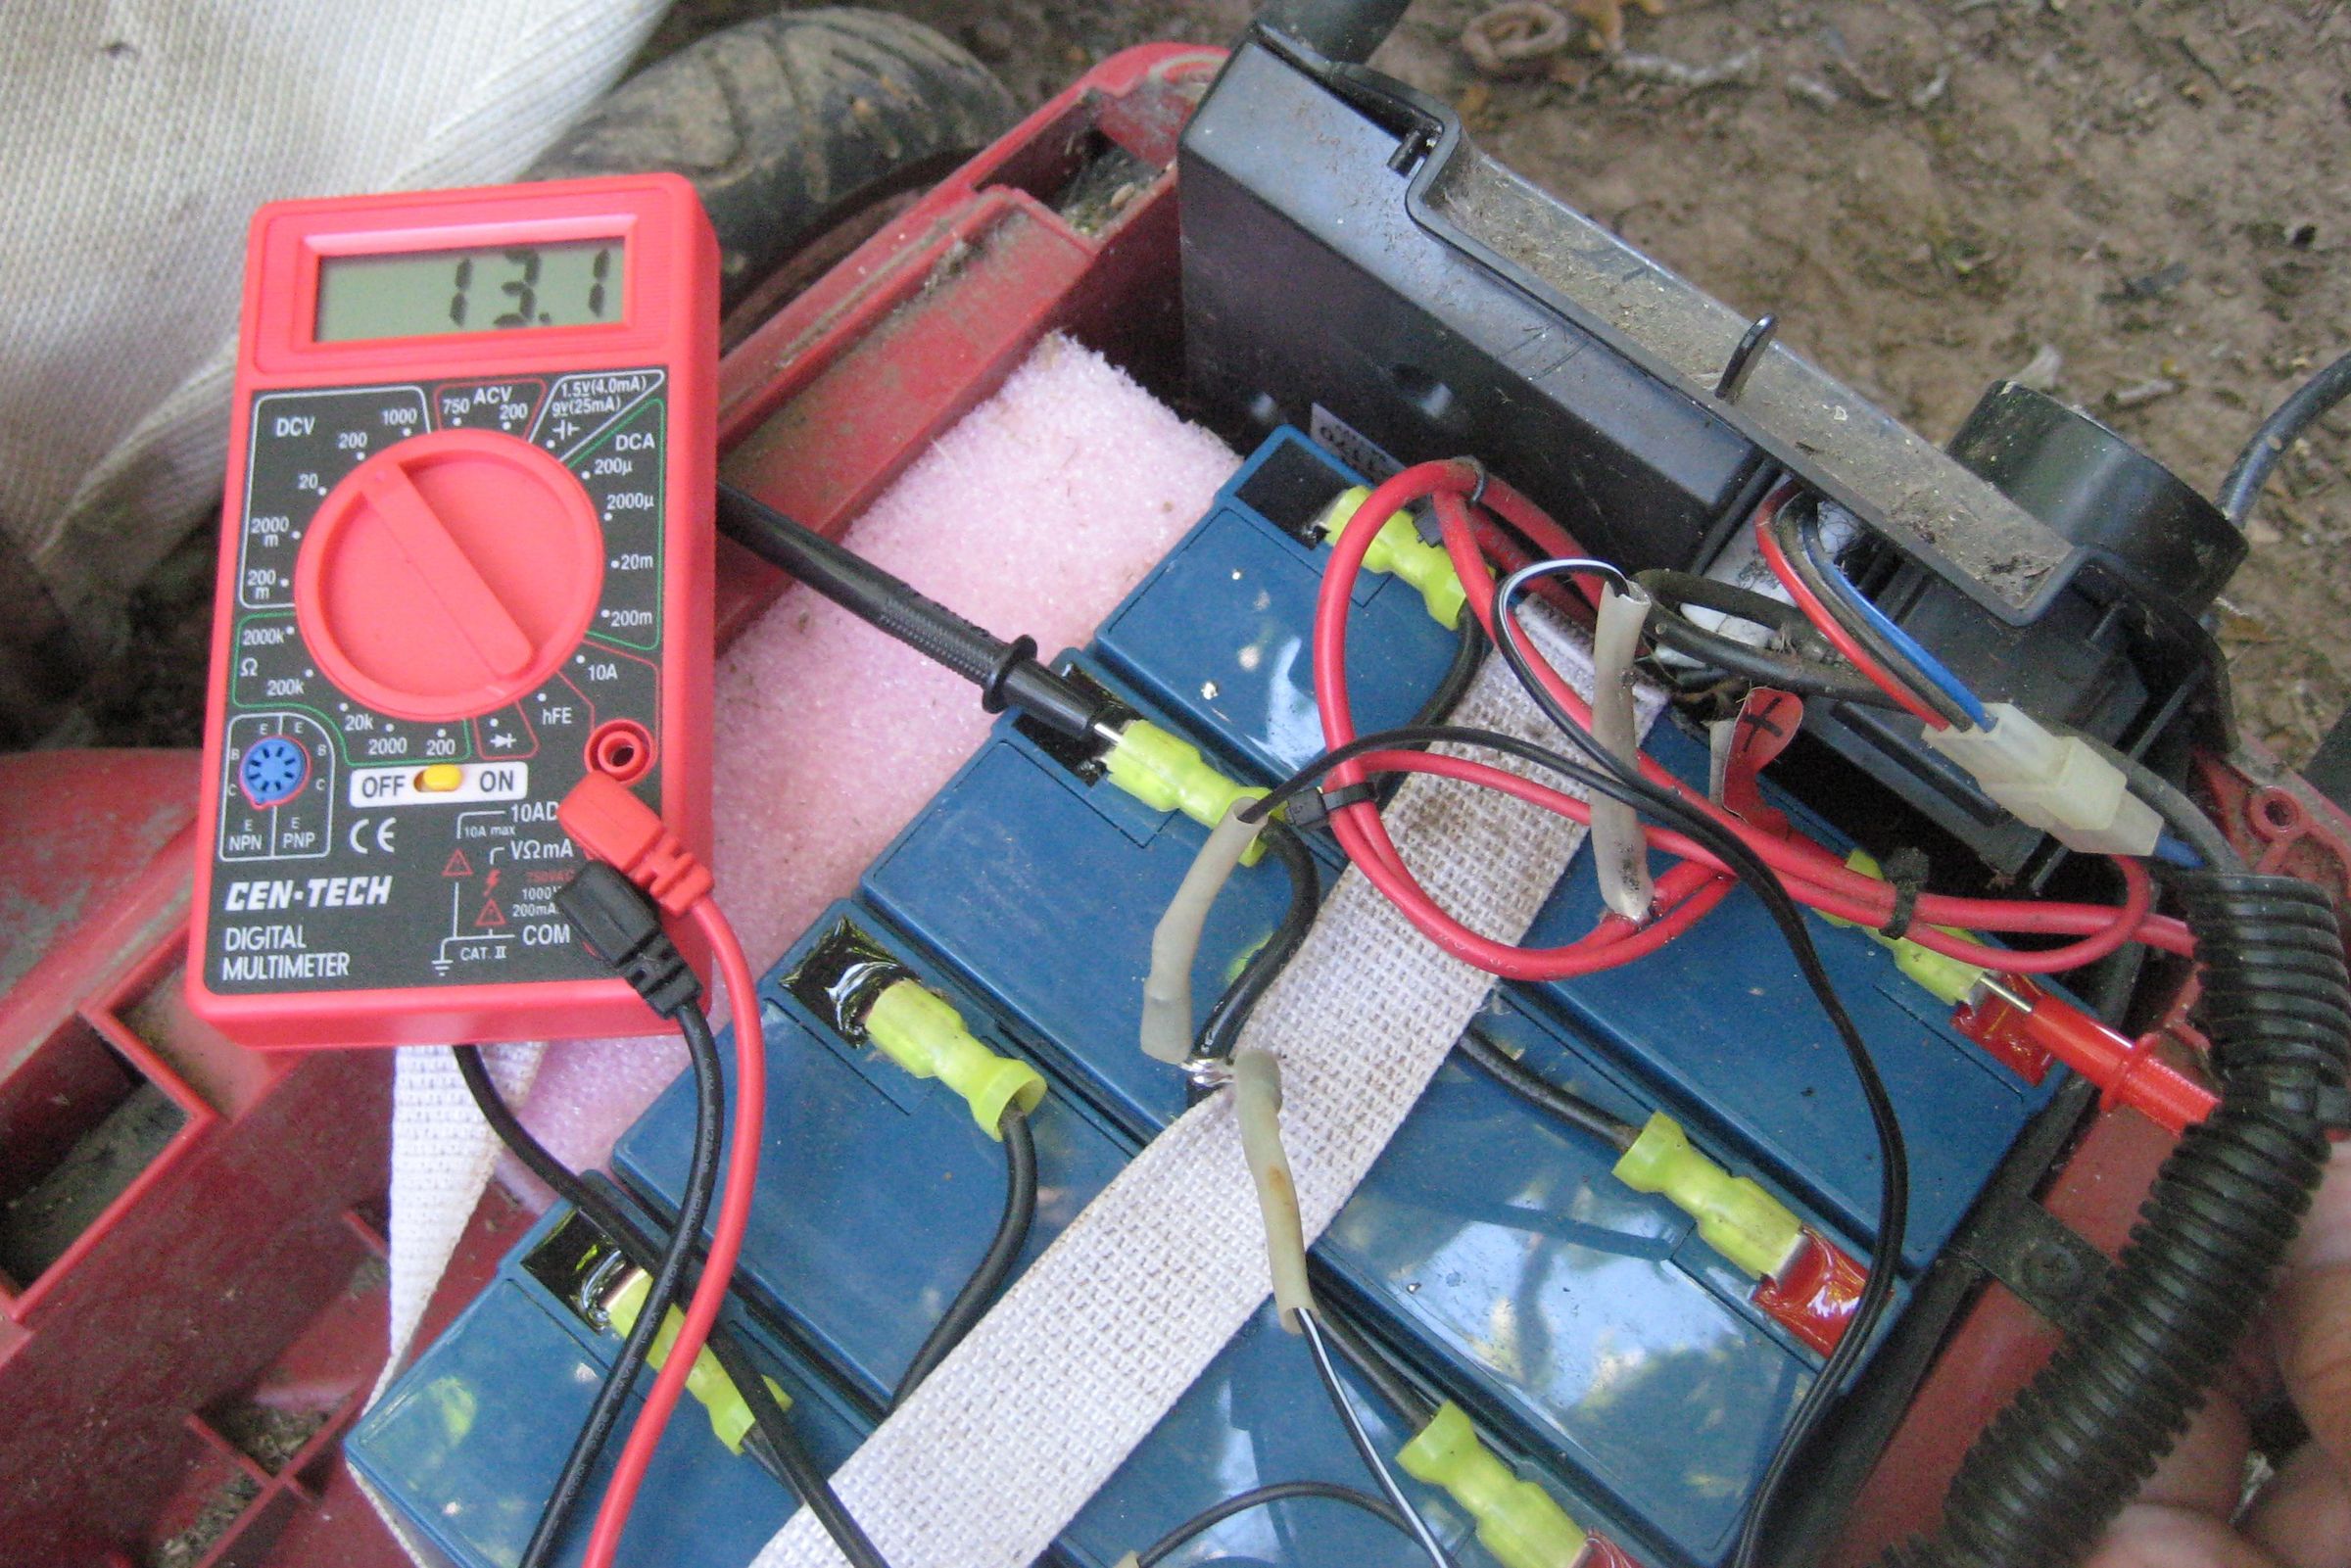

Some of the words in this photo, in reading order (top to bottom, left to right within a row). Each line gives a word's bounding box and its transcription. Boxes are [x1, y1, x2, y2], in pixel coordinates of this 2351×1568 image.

[450, 248, 611, 328] 13.1
[473, 386, 513, 404] ACV
[381, 407, 418, 425] 1000
[443, 398, 470, 415] 750
[499, 403, 528, 420] 200
[274, 415, 315, 438] DCV
[337, 431, 368, 450] 200
[614, 432, 656, 451] DCA
[297, 472, 319, 490] 20
[251, 516, 290, 534] 2000
[620, 553, 654, 570] 20m
[247, 569, 277, 587] 200
[610, 609, 653, 627] 200m
[243, 628, 286, 646] 2000k
[240, 657, 259, 678] Ω
[588, 663, 618, 682] 10A
[266, 679, 306, 697] 200k
[344, 713, 375, 732] 20k
[542, 707, 573, 726] hFE
[367, 736, 408, 756] 2000
[425, 738, 456, 756] 200
[361, 776, 406, 798] OFF
[480, 770, 515, 792] ON
[510, 801, 559, 823] 10AD
[228, 834, 264, 851] NPN
[282, 832, 315, 849] PNP
[224, 925, 308, 951] DIGITAL
[522, 924, 571, 946] COM
[221, 951, 351, 981] MULTIMETER
